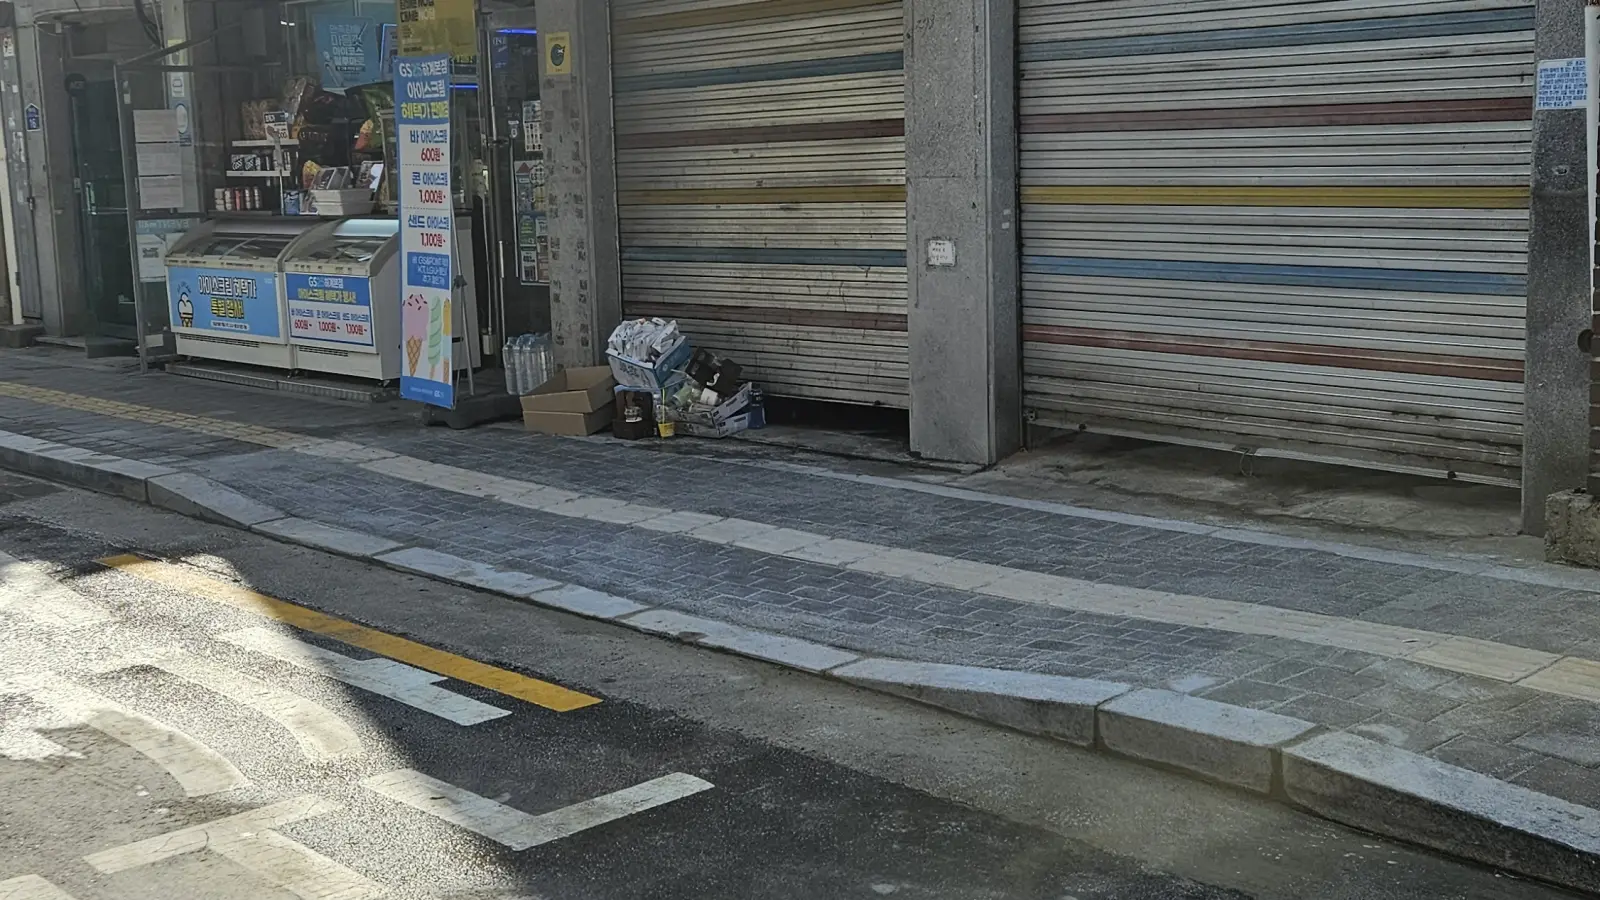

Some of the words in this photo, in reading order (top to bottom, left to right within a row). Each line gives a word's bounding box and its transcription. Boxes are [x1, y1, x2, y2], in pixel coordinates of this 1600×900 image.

[407, 79, 446, 99] 아이스크림
[401, 102, 430, 120] 혜택가
[410, 130, 419, 144] 바
[412, 172, 421, 184] 콘
[408, 214, 425, 228] 샌드
[198, 275, 233, 297] 아이스크림
[233, 277, 257, 299] 혜택가
